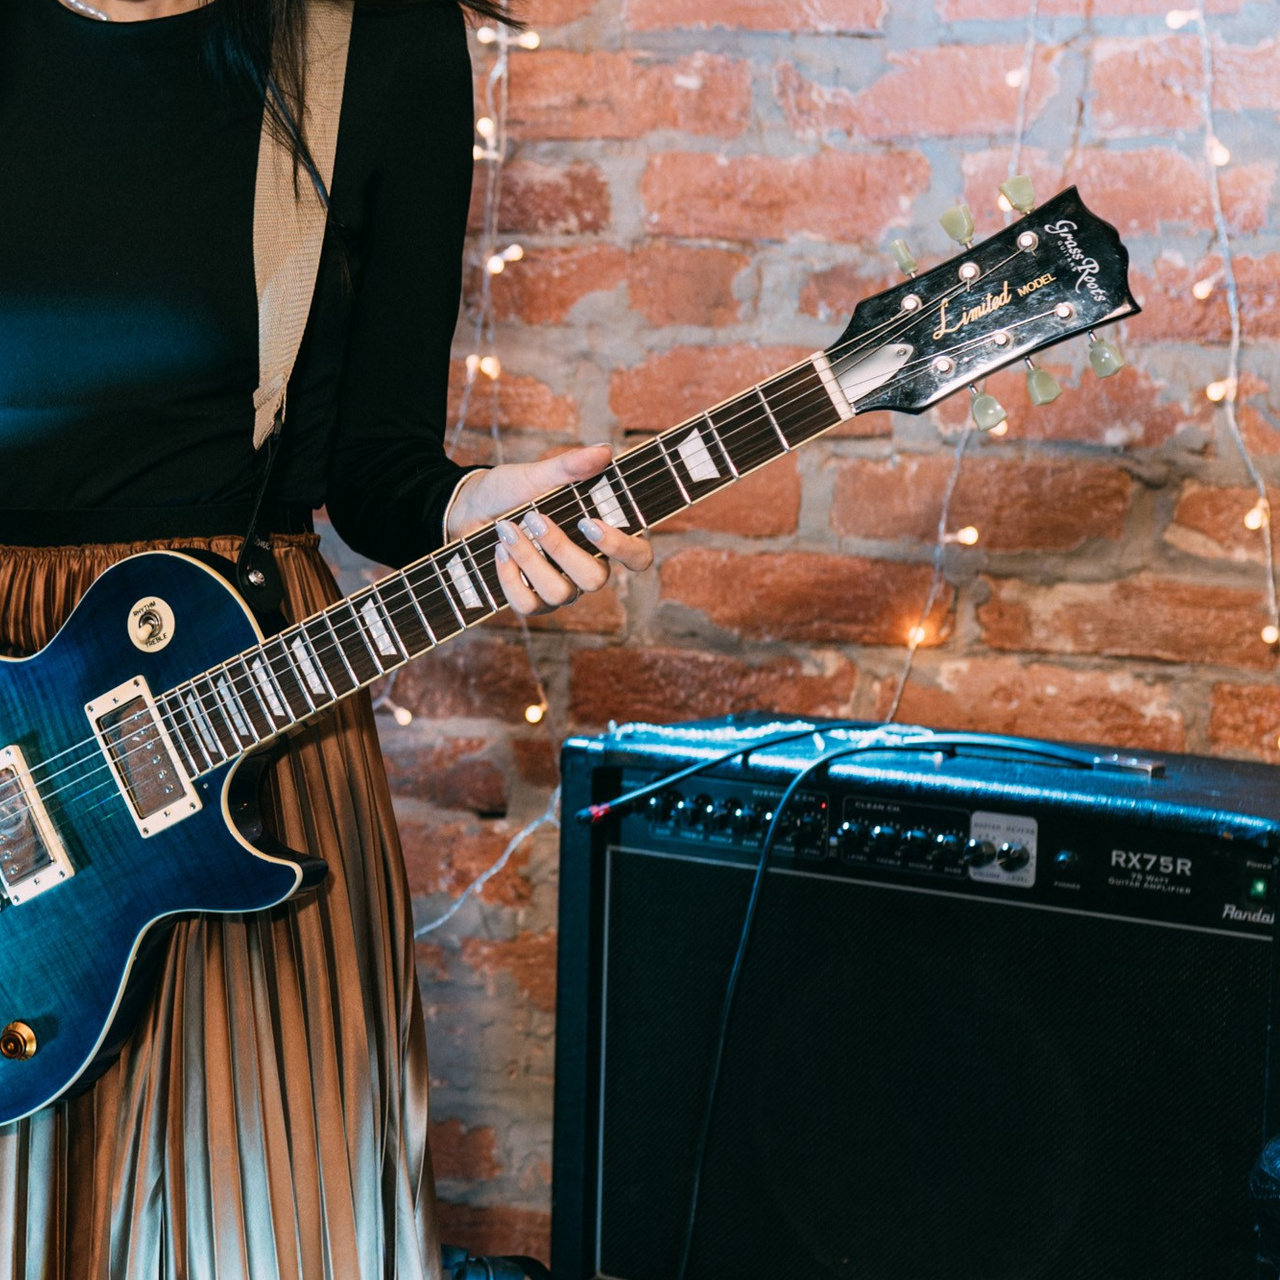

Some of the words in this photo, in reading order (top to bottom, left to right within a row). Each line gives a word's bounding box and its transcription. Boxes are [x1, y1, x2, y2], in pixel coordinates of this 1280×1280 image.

[932, 280, 1012, 340] Limited
[1017, 272, 1057, 297] MODEL
[132, 600, 156, 617] RHYTHM
[145, 632, 167, 648] TREBLE
[1110, 848, 1192, 877] RX75R
